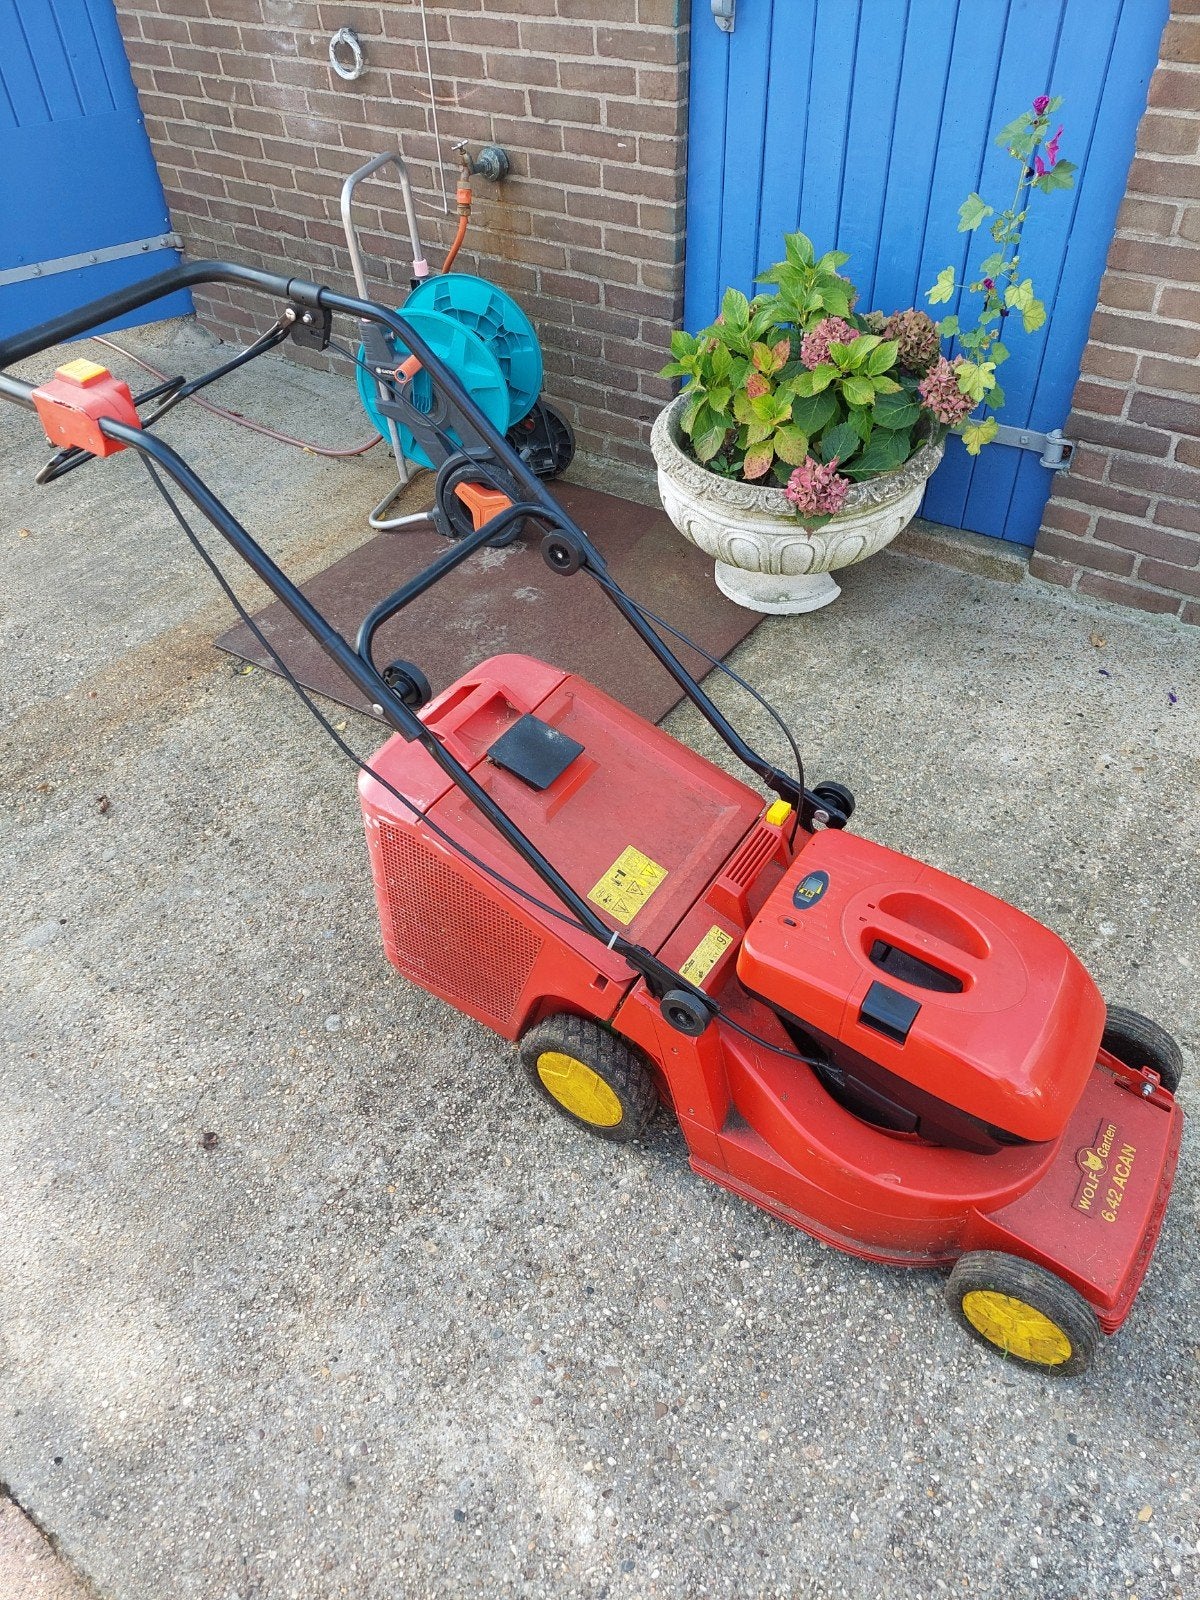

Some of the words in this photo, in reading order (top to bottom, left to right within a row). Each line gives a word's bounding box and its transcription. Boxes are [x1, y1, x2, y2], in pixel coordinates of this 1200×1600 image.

[1078, 1171, 1100, 1210] WOLF
[1096, 1124, 1117, 1158] Garten
[1101, 1188, 1123, 1223] 6.42
[1112, 1143, 1137, 1190] ACAN
